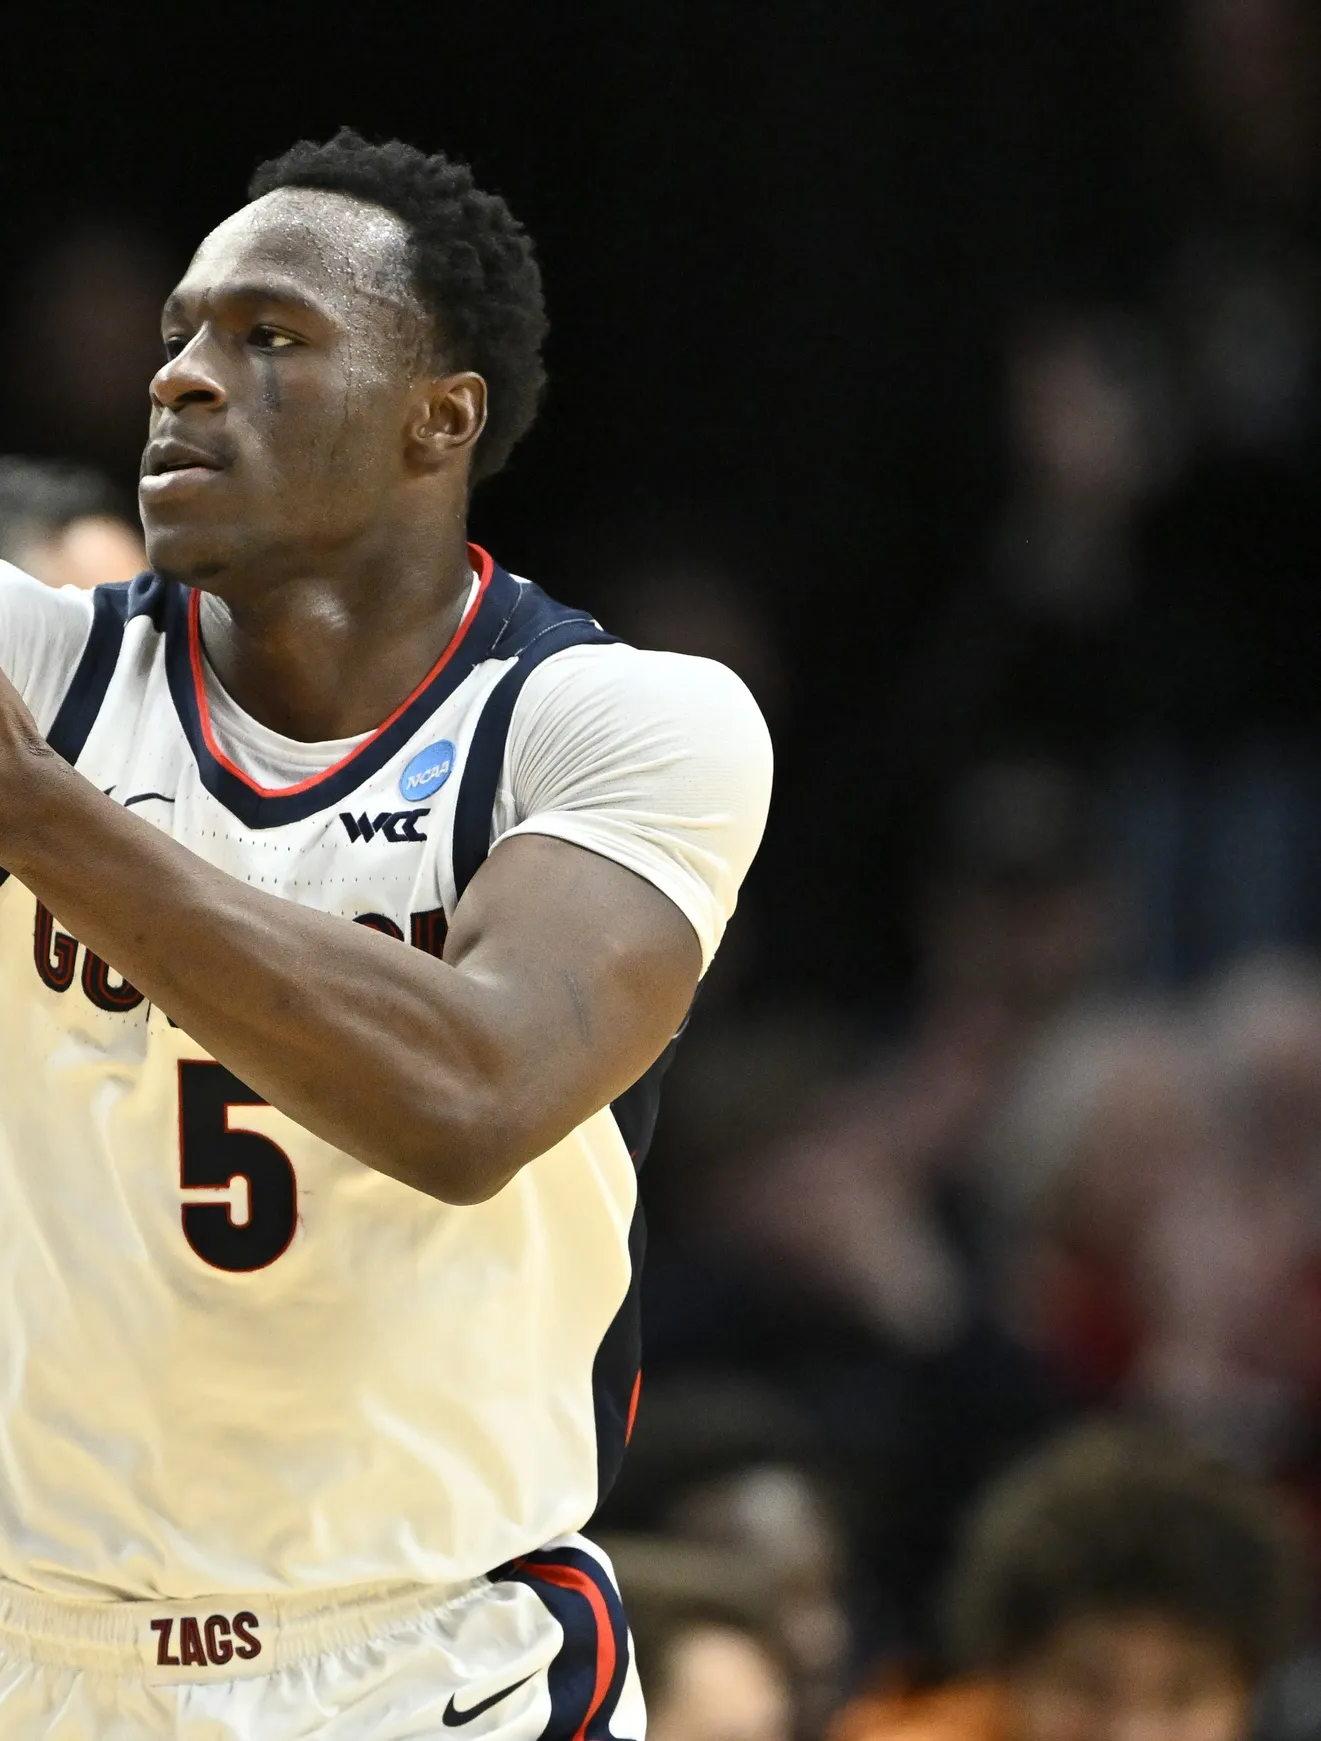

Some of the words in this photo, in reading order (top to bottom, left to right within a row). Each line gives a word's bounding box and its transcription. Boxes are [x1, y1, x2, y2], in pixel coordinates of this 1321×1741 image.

[405, 760, 450, 790] NCAA
[339, 808, 431, 843] WCC
[177, 1059, 297, 1273] 5
[150, 1611, 262, 1666] ZAGS
